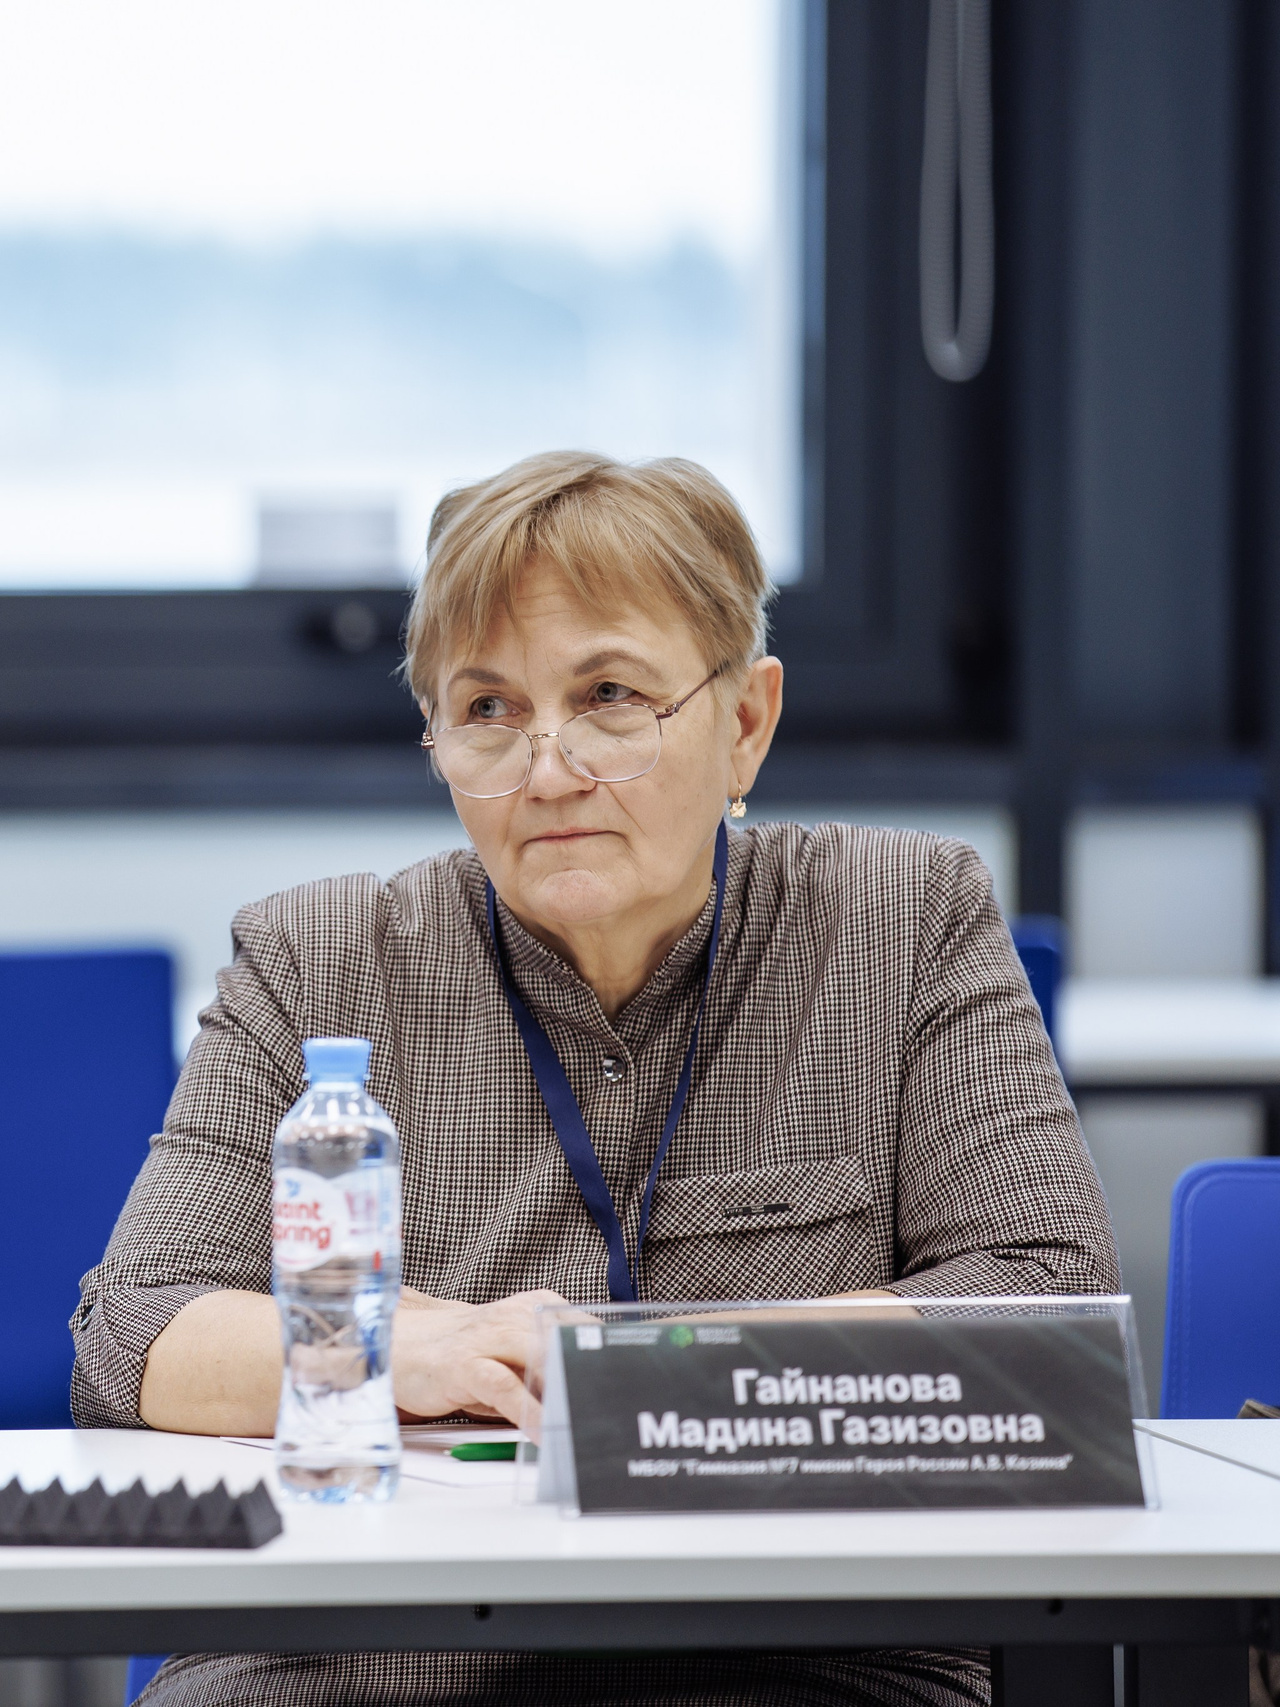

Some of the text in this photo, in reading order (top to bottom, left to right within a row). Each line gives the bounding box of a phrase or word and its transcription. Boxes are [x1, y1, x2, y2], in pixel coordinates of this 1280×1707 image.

[732, 1368, 963, 1405] Гайнанова
[637, 1408, 1046, 1453] Мадина Газизовна
[627, 1459, 679, 1477] МБОУ
